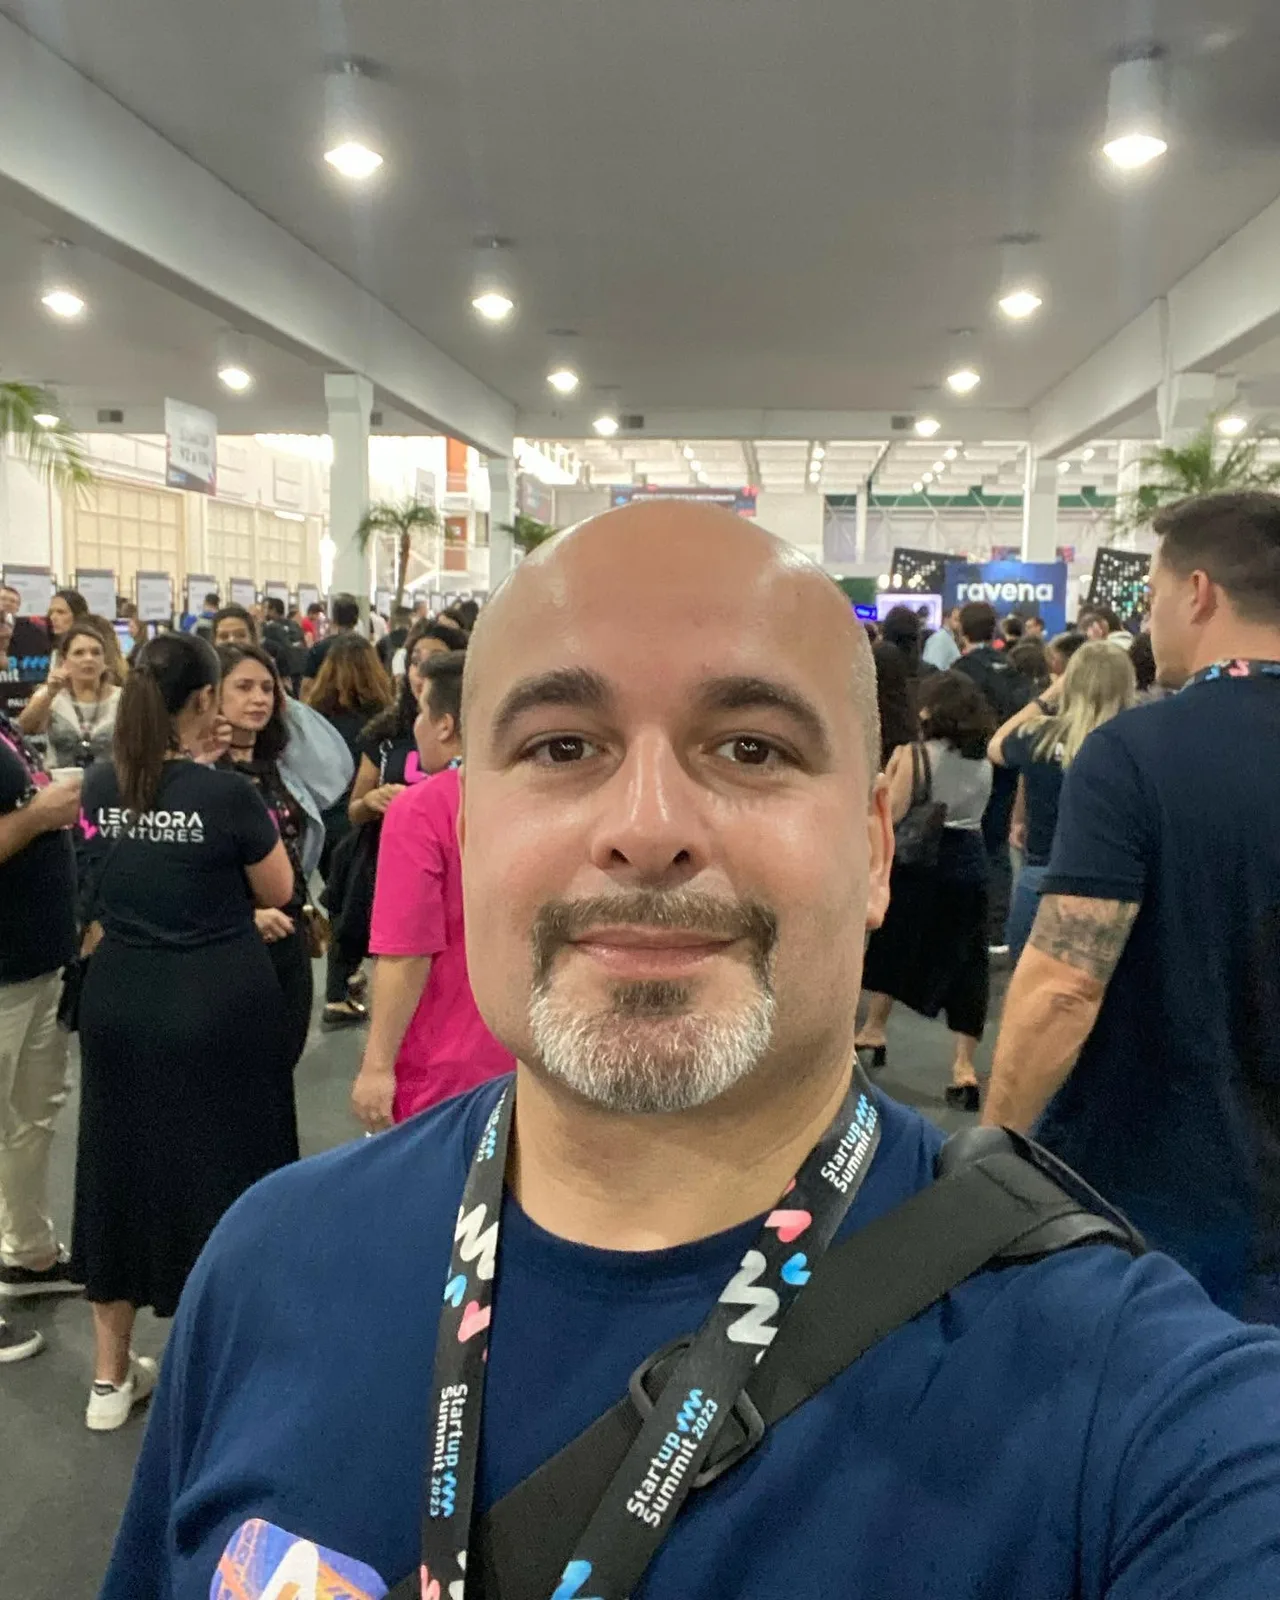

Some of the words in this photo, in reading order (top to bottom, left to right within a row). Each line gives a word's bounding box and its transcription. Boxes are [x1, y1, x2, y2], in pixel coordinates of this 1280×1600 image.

[957, 582, 1053, 602] ravena
[820, 1121, 861, 1182] Startup
[833, 1129, 871, 1193] Summit
[432, 1385, 453, 1472] Summit
[444, 1383, 468, 1467] Startup
[429, 1476, 442, 1517] 2023
[626, 1431, 681, 1518] Startup
[643, 1437, 698, 1528] Summit
[691, 1398, 719, 1441] 2023
